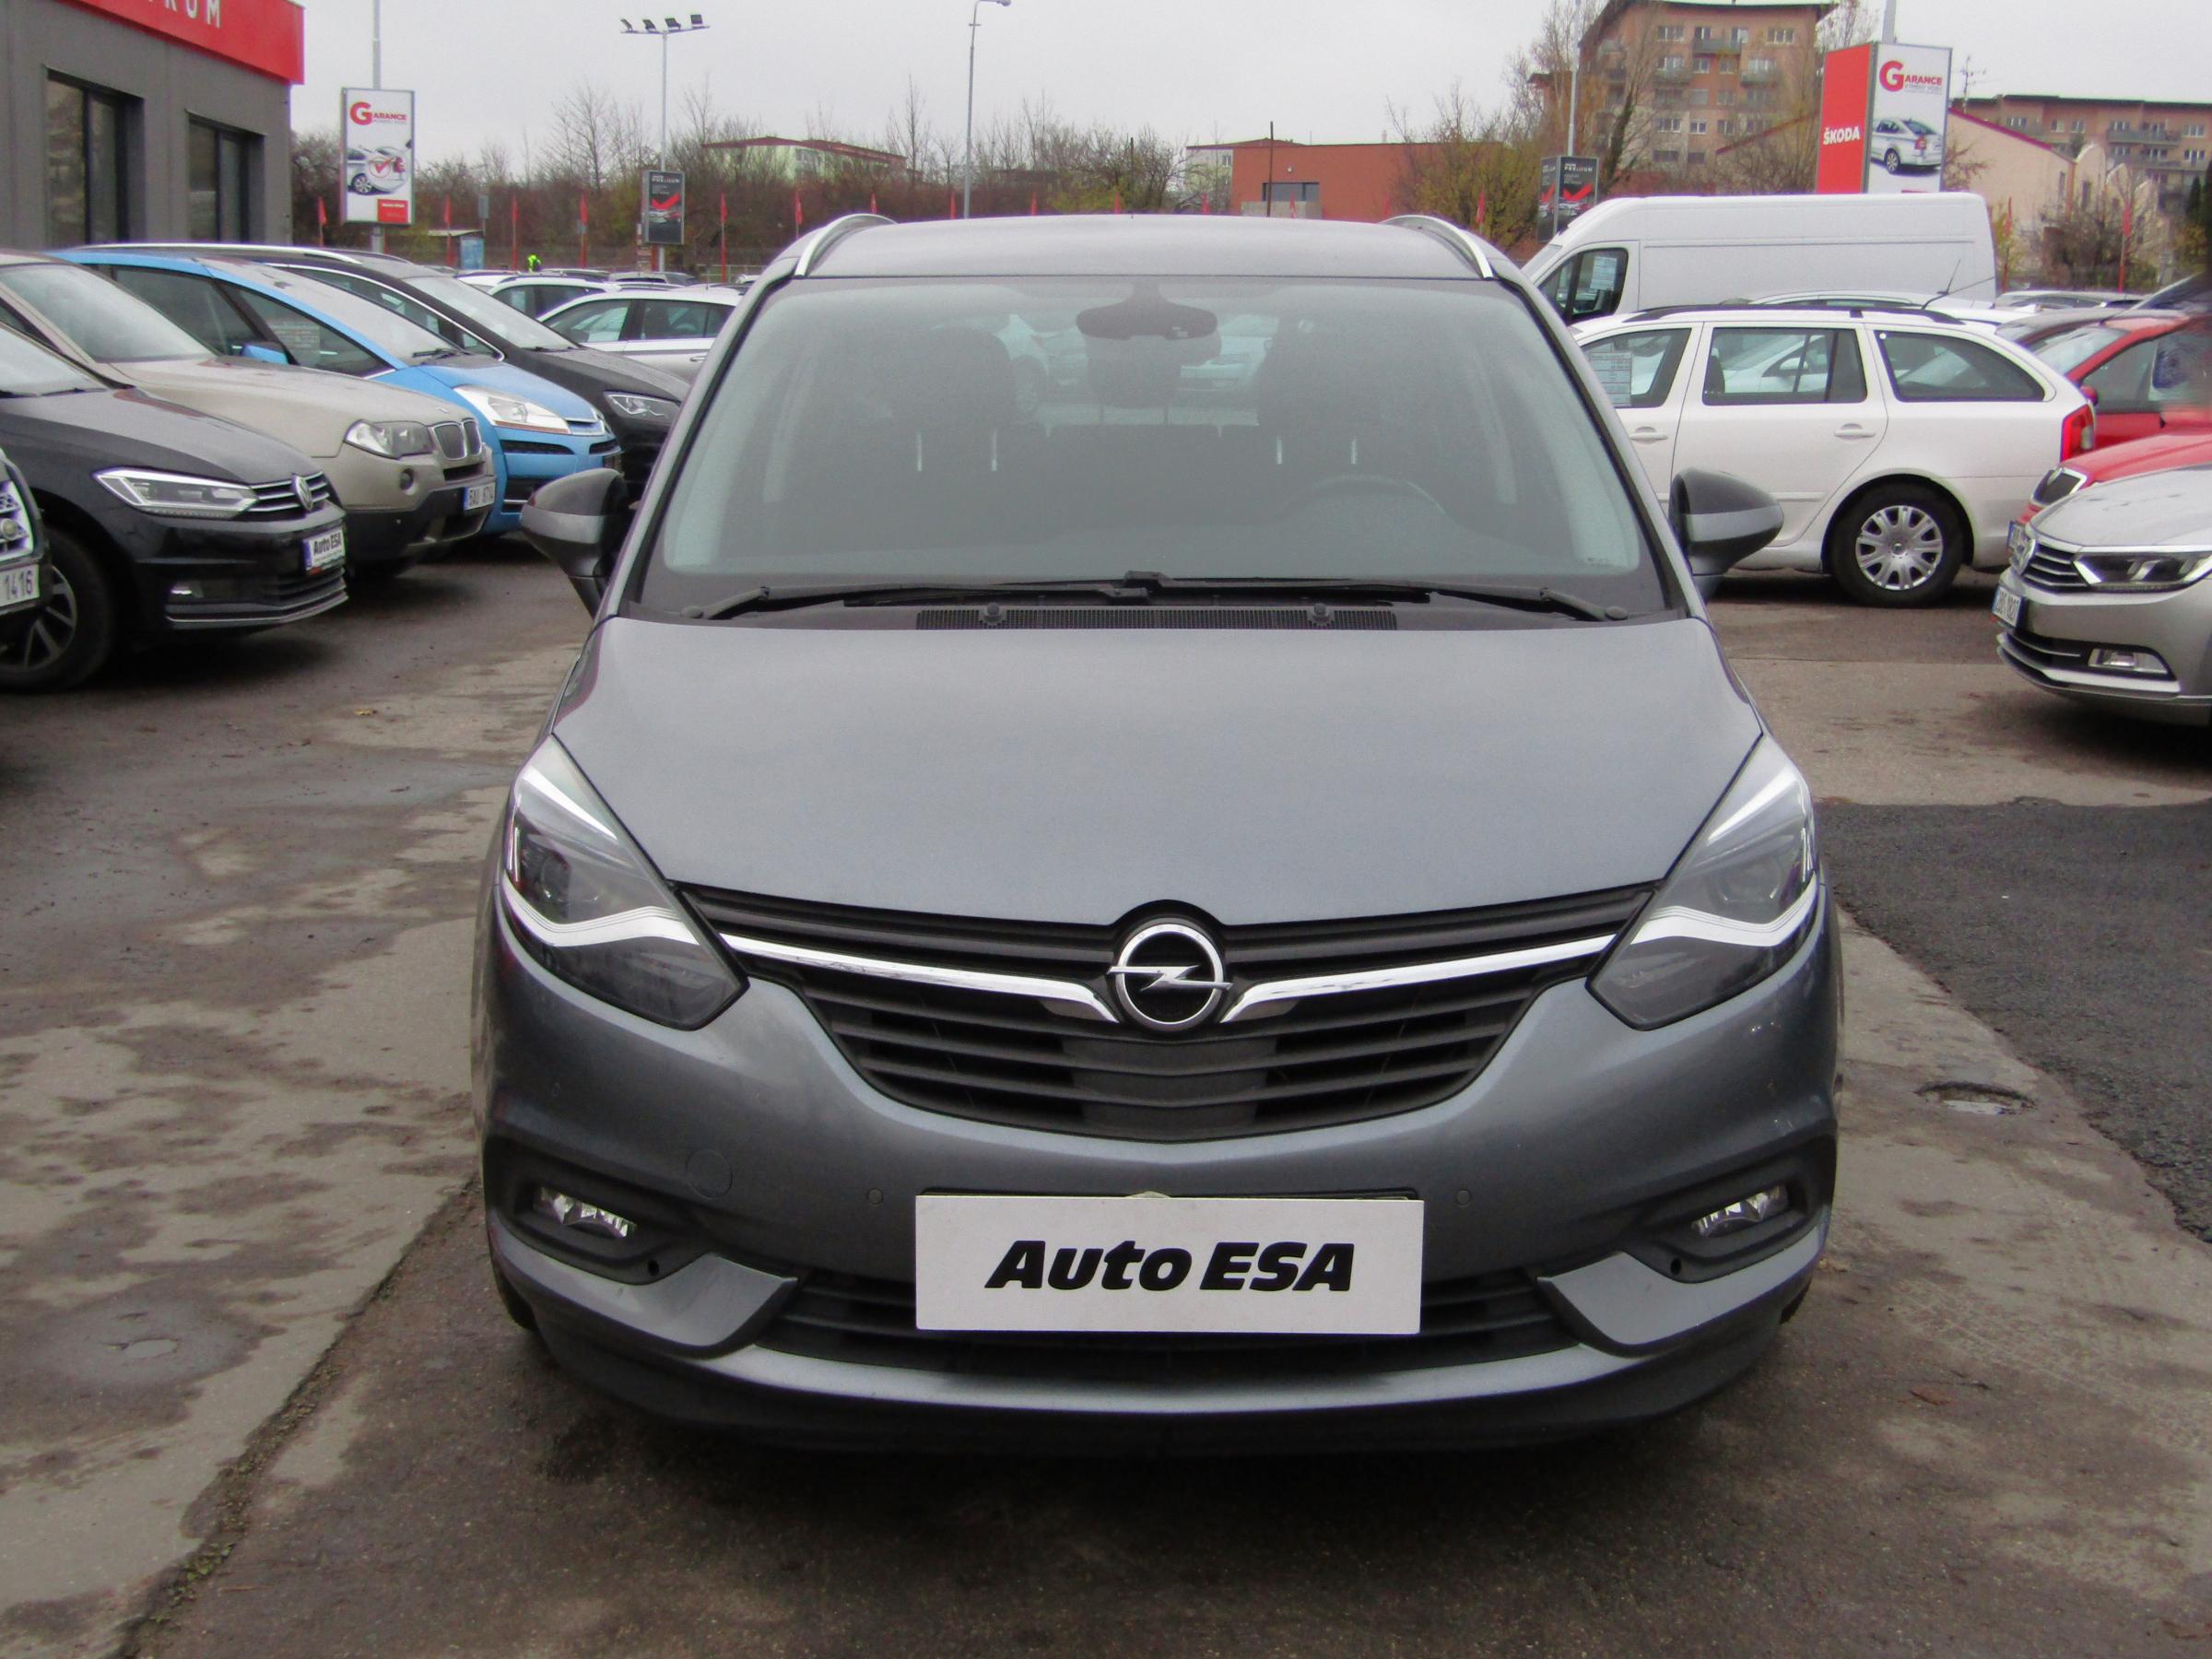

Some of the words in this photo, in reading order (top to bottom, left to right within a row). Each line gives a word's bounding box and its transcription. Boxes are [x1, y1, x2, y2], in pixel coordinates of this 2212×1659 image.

[1879, 60, 1943, 91] GARANCE
[350, 101, 407, 125] GARANCE
[1823, 126, 1860, 145] ŠKODA
[984, 1241, 1193, 1291] Auto
[1199, 1241, 1355, 1291] ESA
